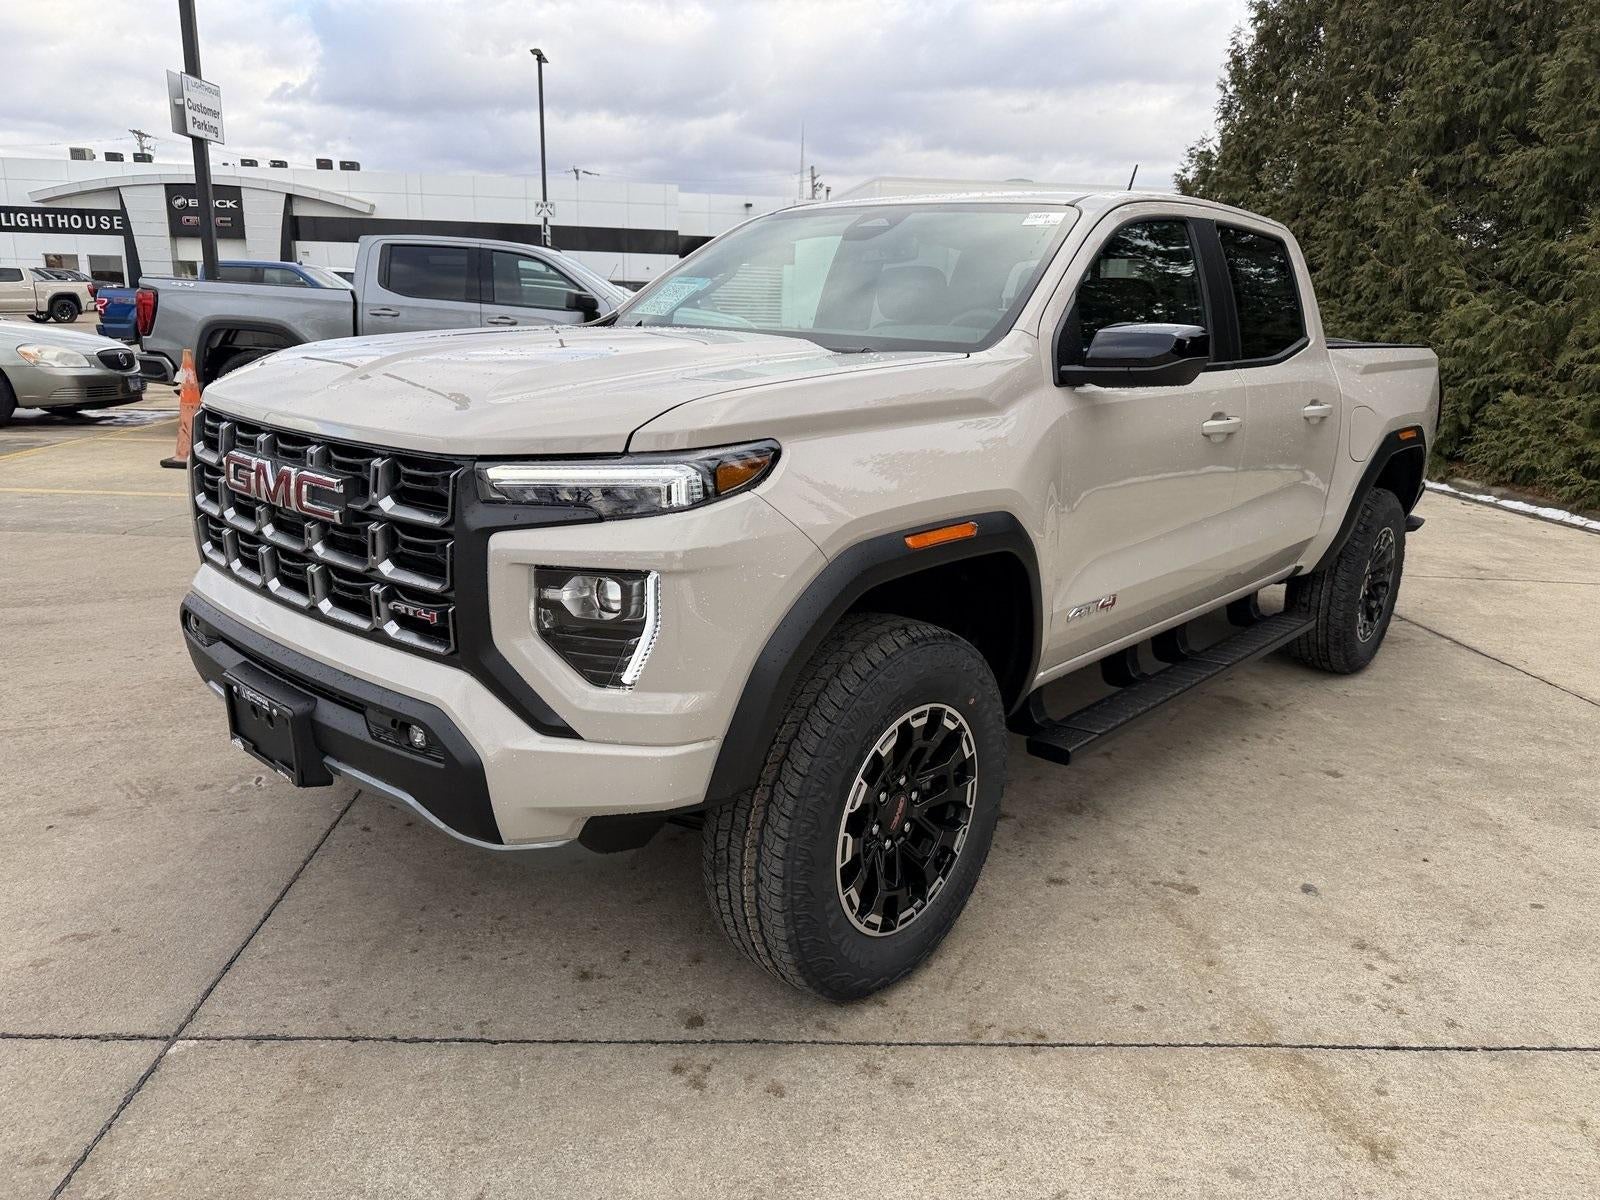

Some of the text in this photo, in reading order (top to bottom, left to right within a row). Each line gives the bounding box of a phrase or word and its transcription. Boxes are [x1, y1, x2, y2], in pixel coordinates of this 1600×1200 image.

[187, 98, 220, 119] Customer
[192, 116, 219, 138] Parking
[188, 199, 239, 209] BICK
[0, 212, 124, 230] LIGHTHOUSE
[181, 215, 232, 228] GC
[223, 450, 344, 524] GMC
[388, 601, 438, 625] AT4
[1066, 593, 1117, 623] AT4
